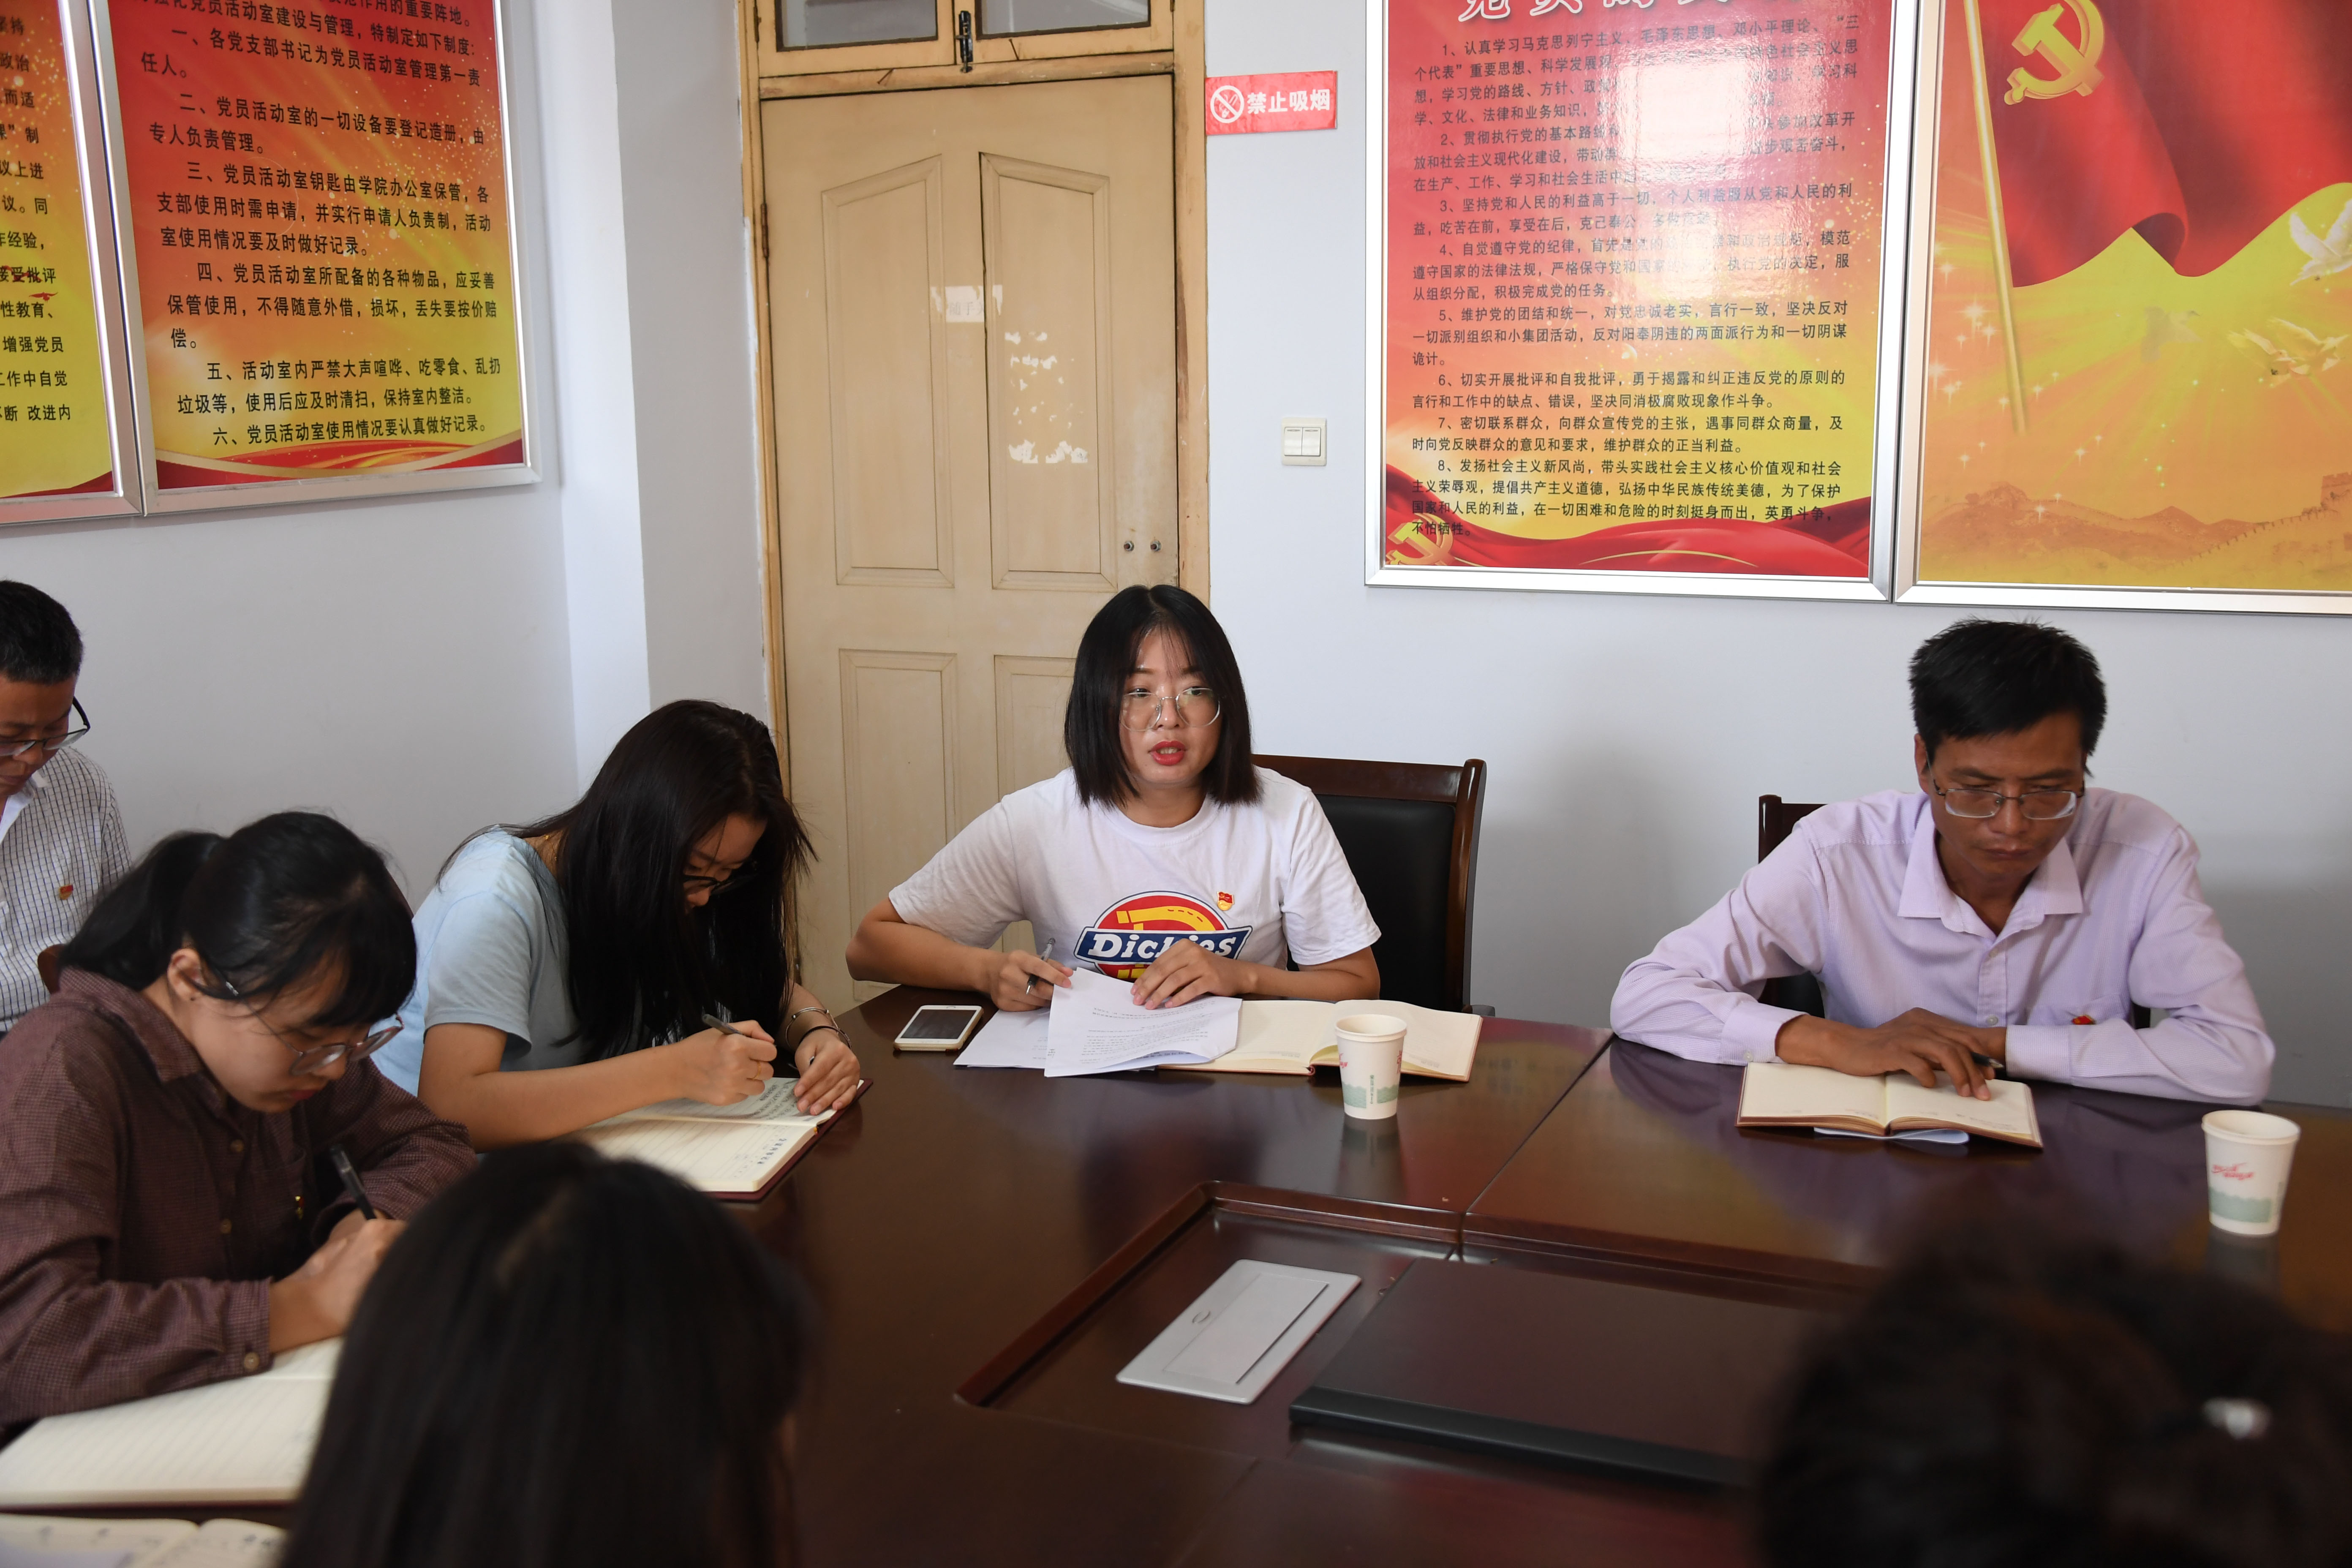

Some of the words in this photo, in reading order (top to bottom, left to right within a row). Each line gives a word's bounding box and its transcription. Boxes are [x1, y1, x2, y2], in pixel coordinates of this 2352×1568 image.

[141, 52, 186, 79] 任人。
[171, 27, 479, 87] 一、各党支部书记为党员活动室管理第一责
[1247, 89, 1330, 114] 禁止吸烟
[179, 93, 485, 145] 二、党员活动室的一切设备要登记造册，由
[150, 121, 264, 155] 专人负责管理。
[187, 161, 489, 204] 三、党员活动室钥匙由学院办公室保管，各
[2, 195, 48, 215] 议。同
[1440, 183, 1853, 212] 3、坚持党和人民的利益高于一切，个人利益服从党和人民的利
[156, 191, 492, 232] 支部使用时需申请，并实行申请人负责制，活动
[161, 226, 367, 257] 室使用情况要及时做好记录。
[197, 262, 495, 290] 四、党员活动室所配备的各种物品，应妥善
[1413, 283, 1614, 302] 从组织分配，积极完成党的任务。
[0, 300, 53, 318] 性教育、
[167, 294, 497, 318] 保管使用，不得随意外借，损坏，丢失要按价赔
[1439, 300, 1848, 324] 5、维护党的团结和统一，对党忠诚老实，言行一致，坚决反对
[3, 336, 64, 353] 增强党员
[171, 328, 197, 349] 偿。
[1413, 323, 1848, 345] 一切派别组织和小集团活动，反对阳奉阴违的两面派行为和一切阴谋
[207, 357, 501, 381] 五、活动室内严禁大声喧哗、吃零食、乱扔
[1412, 352, 1445, 367] 诡计。
[1438, 369, 1846, 387] 6、切实开展批评和自我批评，勇于揭露和纠正违反党的原则的
[177, 388, 472, 415] 垃圾等，使用后应及时清扫，保持室内整洁。
[1412, 392, 1774, 409] 言行和工作中的缺点、错误，坚决同消极腐败现象作斗争。
[213, 415, 486, 446] 六、党员活动室使用情况要认真做好记录。
[1438, 415, 1843, 432] 7、密切联系群众，向群众宣传党的主张，遇事同群众商量，及
[1412, 436, 1742, 453] 时向党反映群众的意见和要求，维护群众的正当利益。
[1437, 459, 1842, 476] 8、发扬社会主义新风尚，带头实践社会主义核心价值观和社会
[1412, 479, 1841, 498] 主义荣辱观，提倡共产主义道德，弘扬中华民族传统美德，为了保护
[1412, 500, 1832, 522] 国家和人民的利益，在一切困难和危险的时刻挺身而出，英勇斗争，
[1411, 520, 1472, 537] 不怕牺牲。
